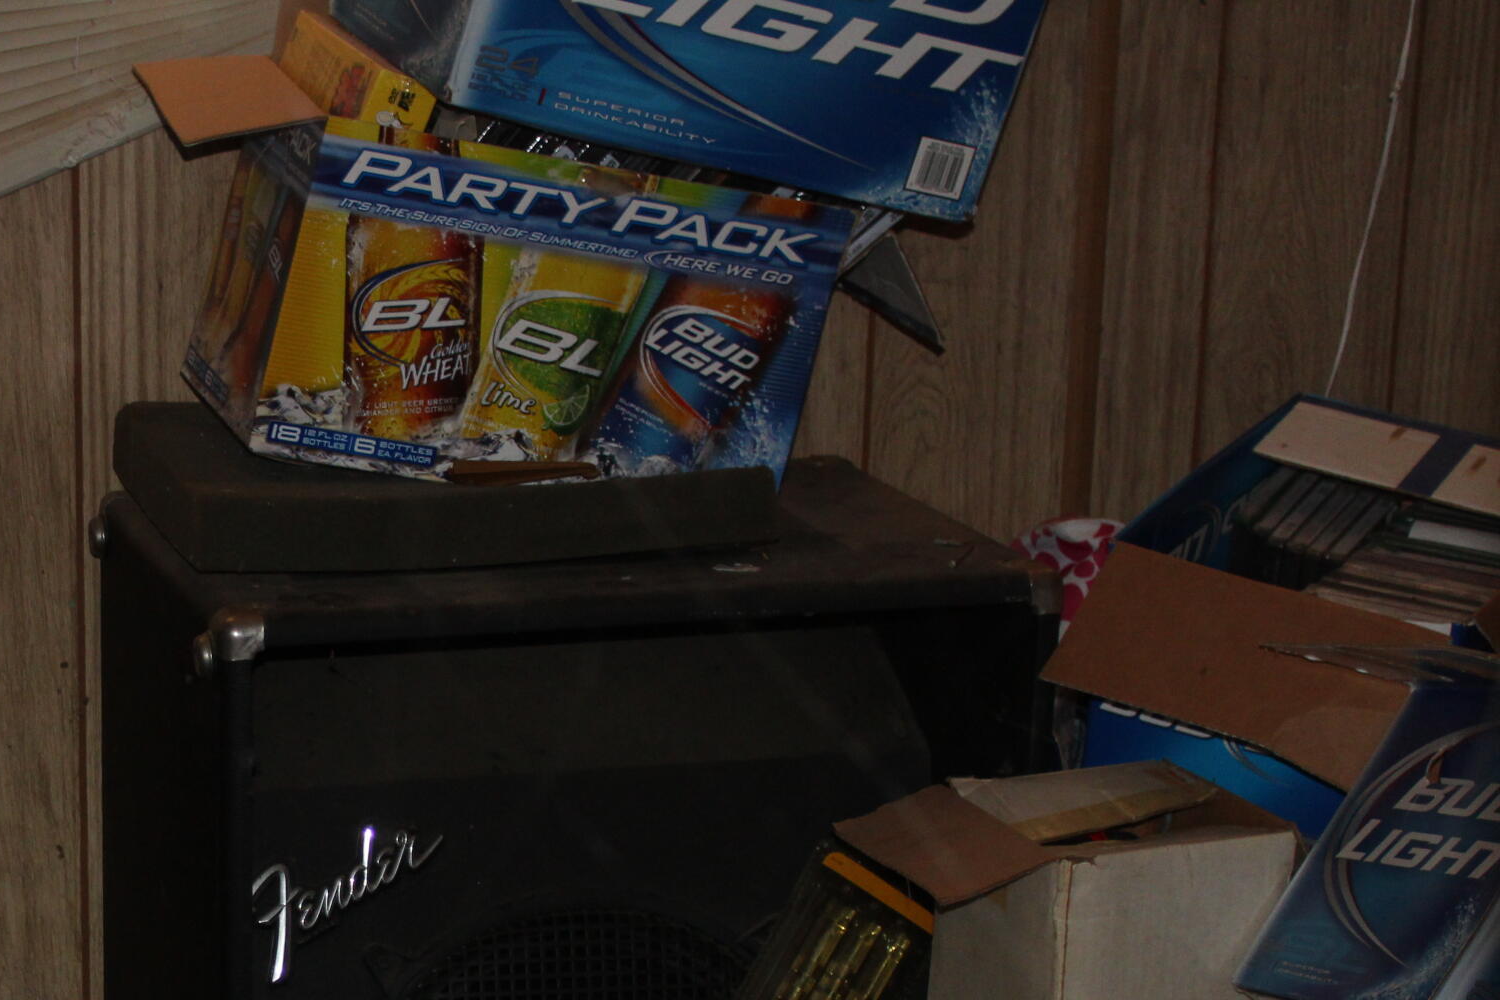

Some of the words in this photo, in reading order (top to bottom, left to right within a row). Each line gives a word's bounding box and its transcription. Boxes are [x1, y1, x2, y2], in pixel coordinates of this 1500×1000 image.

[553, 101, 718, 145] DRINKABILITY
[558, 91, 685, 127] SUPERIOR
[341, 149, 607, 226] PARTY
[611, 198, 820, 265] PACK
[339, 197, 373, 214] IT'S
[374, 201, 411, 220] THE
[410, 208, 460, 230] SURE
[459, 216, 502, 236] SIGN
[504, 224, 530, 242] OF
[527, 228, 639, 260] SUMMERTIME!
[662, 251, 721, 277] HERE
[725, 264, 758, 281] WE
[758, 267, 795, 286] GO
[361, 295, 467, 333] BL
[429, 338, 470, 361] Golden
[496, 317, 604, 379] BL
[644, 326, 753, 392] LIGHT
[671, 316, 762, 372] BUD
[399, 352, 473, 391] WHEAT
[270, 423, 301, 443] 18
[302, 436, 348, 452] BOTTLES
[354, 436, 377, 456] 6
[379, 440, 434, 457] BOTTLES
[397, 451, 433, 466] FLAVOR
[1334, 817, 1500, 880] LIGHT
[252, 825, 444, 984] Fender
